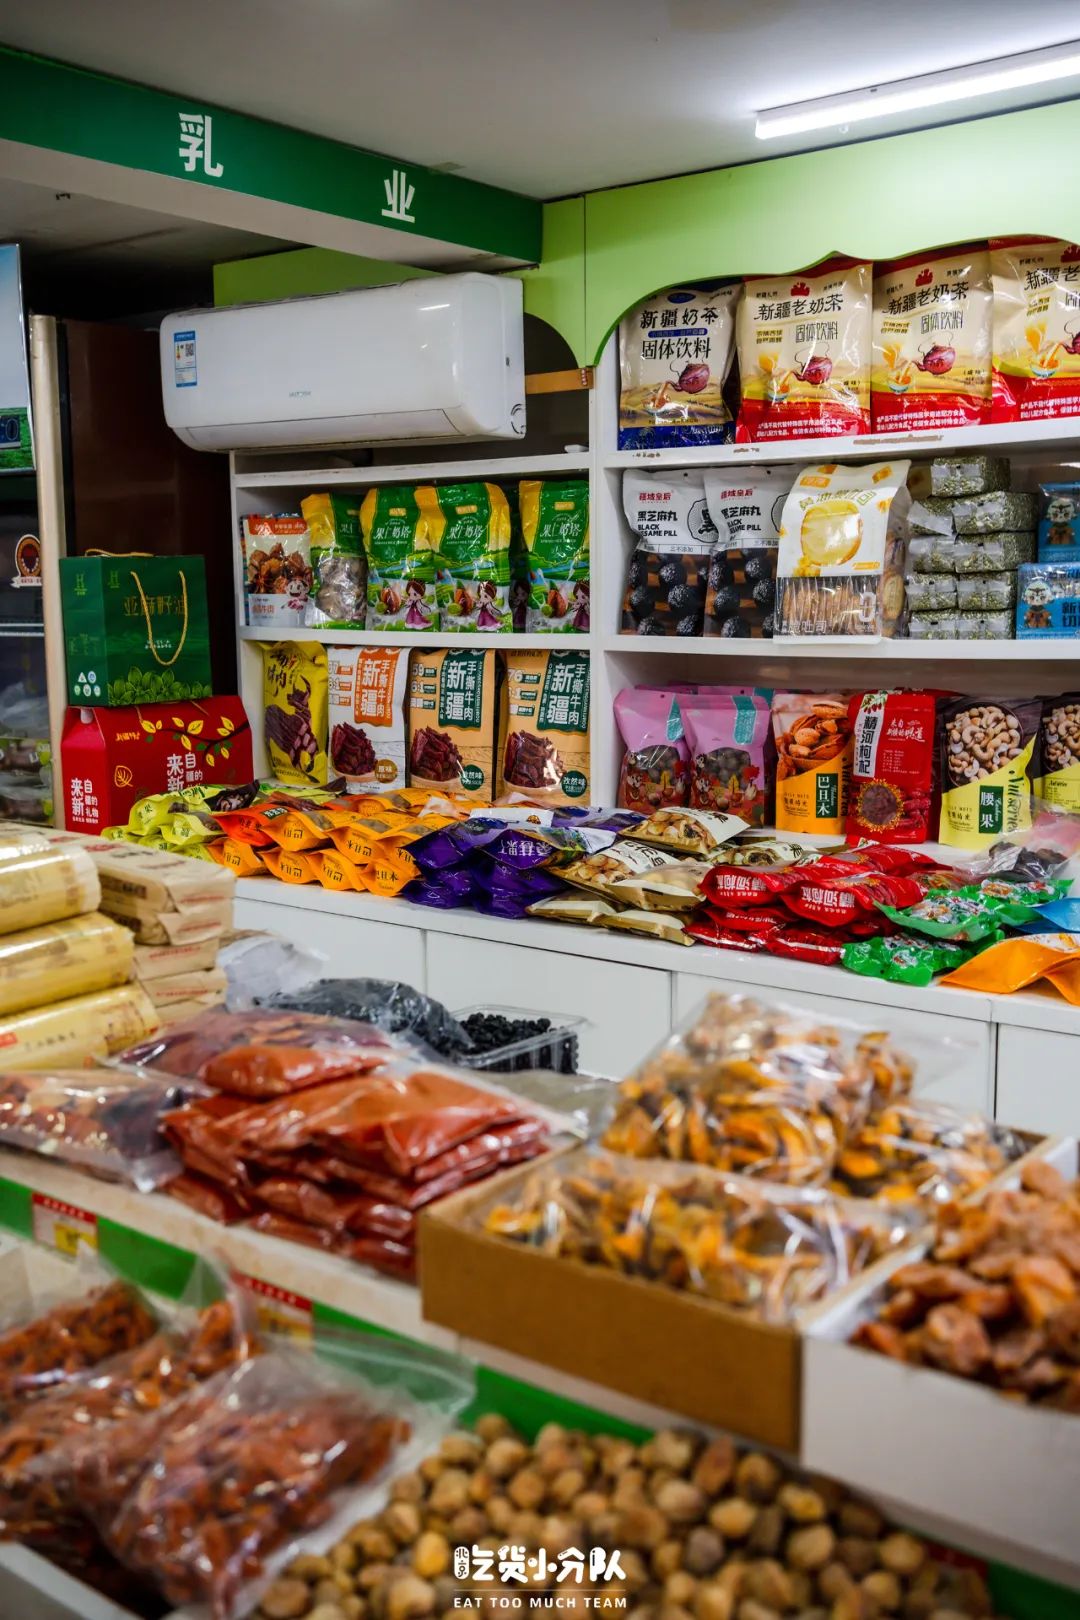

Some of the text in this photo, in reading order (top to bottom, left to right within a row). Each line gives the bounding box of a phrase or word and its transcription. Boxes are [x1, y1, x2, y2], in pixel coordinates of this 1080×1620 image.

[178, 112, 416, 223] 乳 业
[754, 294, 844, 321] 新疆老奶茶
[882, 281, 969, 315] 新疆老奶茶
[640, 306, 719, 329] 新疆奶茶
[920, 310, 964, 334] 固体饮料
[795, 321, 838, 344] 固体饮料
[641, 337, 711, 360] 固体饮料
[637, 510, 678, 522] 黑芝麻丸
[721, 505, 761, 519] 黑芝麻丸
[638, 523, 660, 531] BLACK
[746, 524, 761, 532] PILL
[1062, 601, 1080, 614] 新
[1062, 615, 1080, 628] 切
[412, 663, 425, 677] 59
[361, 660, 380, 718] 新疆
[376, 659, 391, 718] 手撕牛肉
[446, 660, 467, 721] 新疆
[463, 660, 477, 721] 手撕牛肉
[547, 662, 575, 725] 新疆
[568, 663, 587, 726] 手撕牛肉
[858, 715, 878, 775] 精河枸杞
[817, 775, 830, 816] 巴旦木
[980, 791, 995, 828] 腰果
[283, 829, 303, 838] 巴旦
[223, 852, 241, 866] 巴旦
[715, 873, 766, 892] 精河枸杞
[800, 885, 856, 909] 精河枸杞
